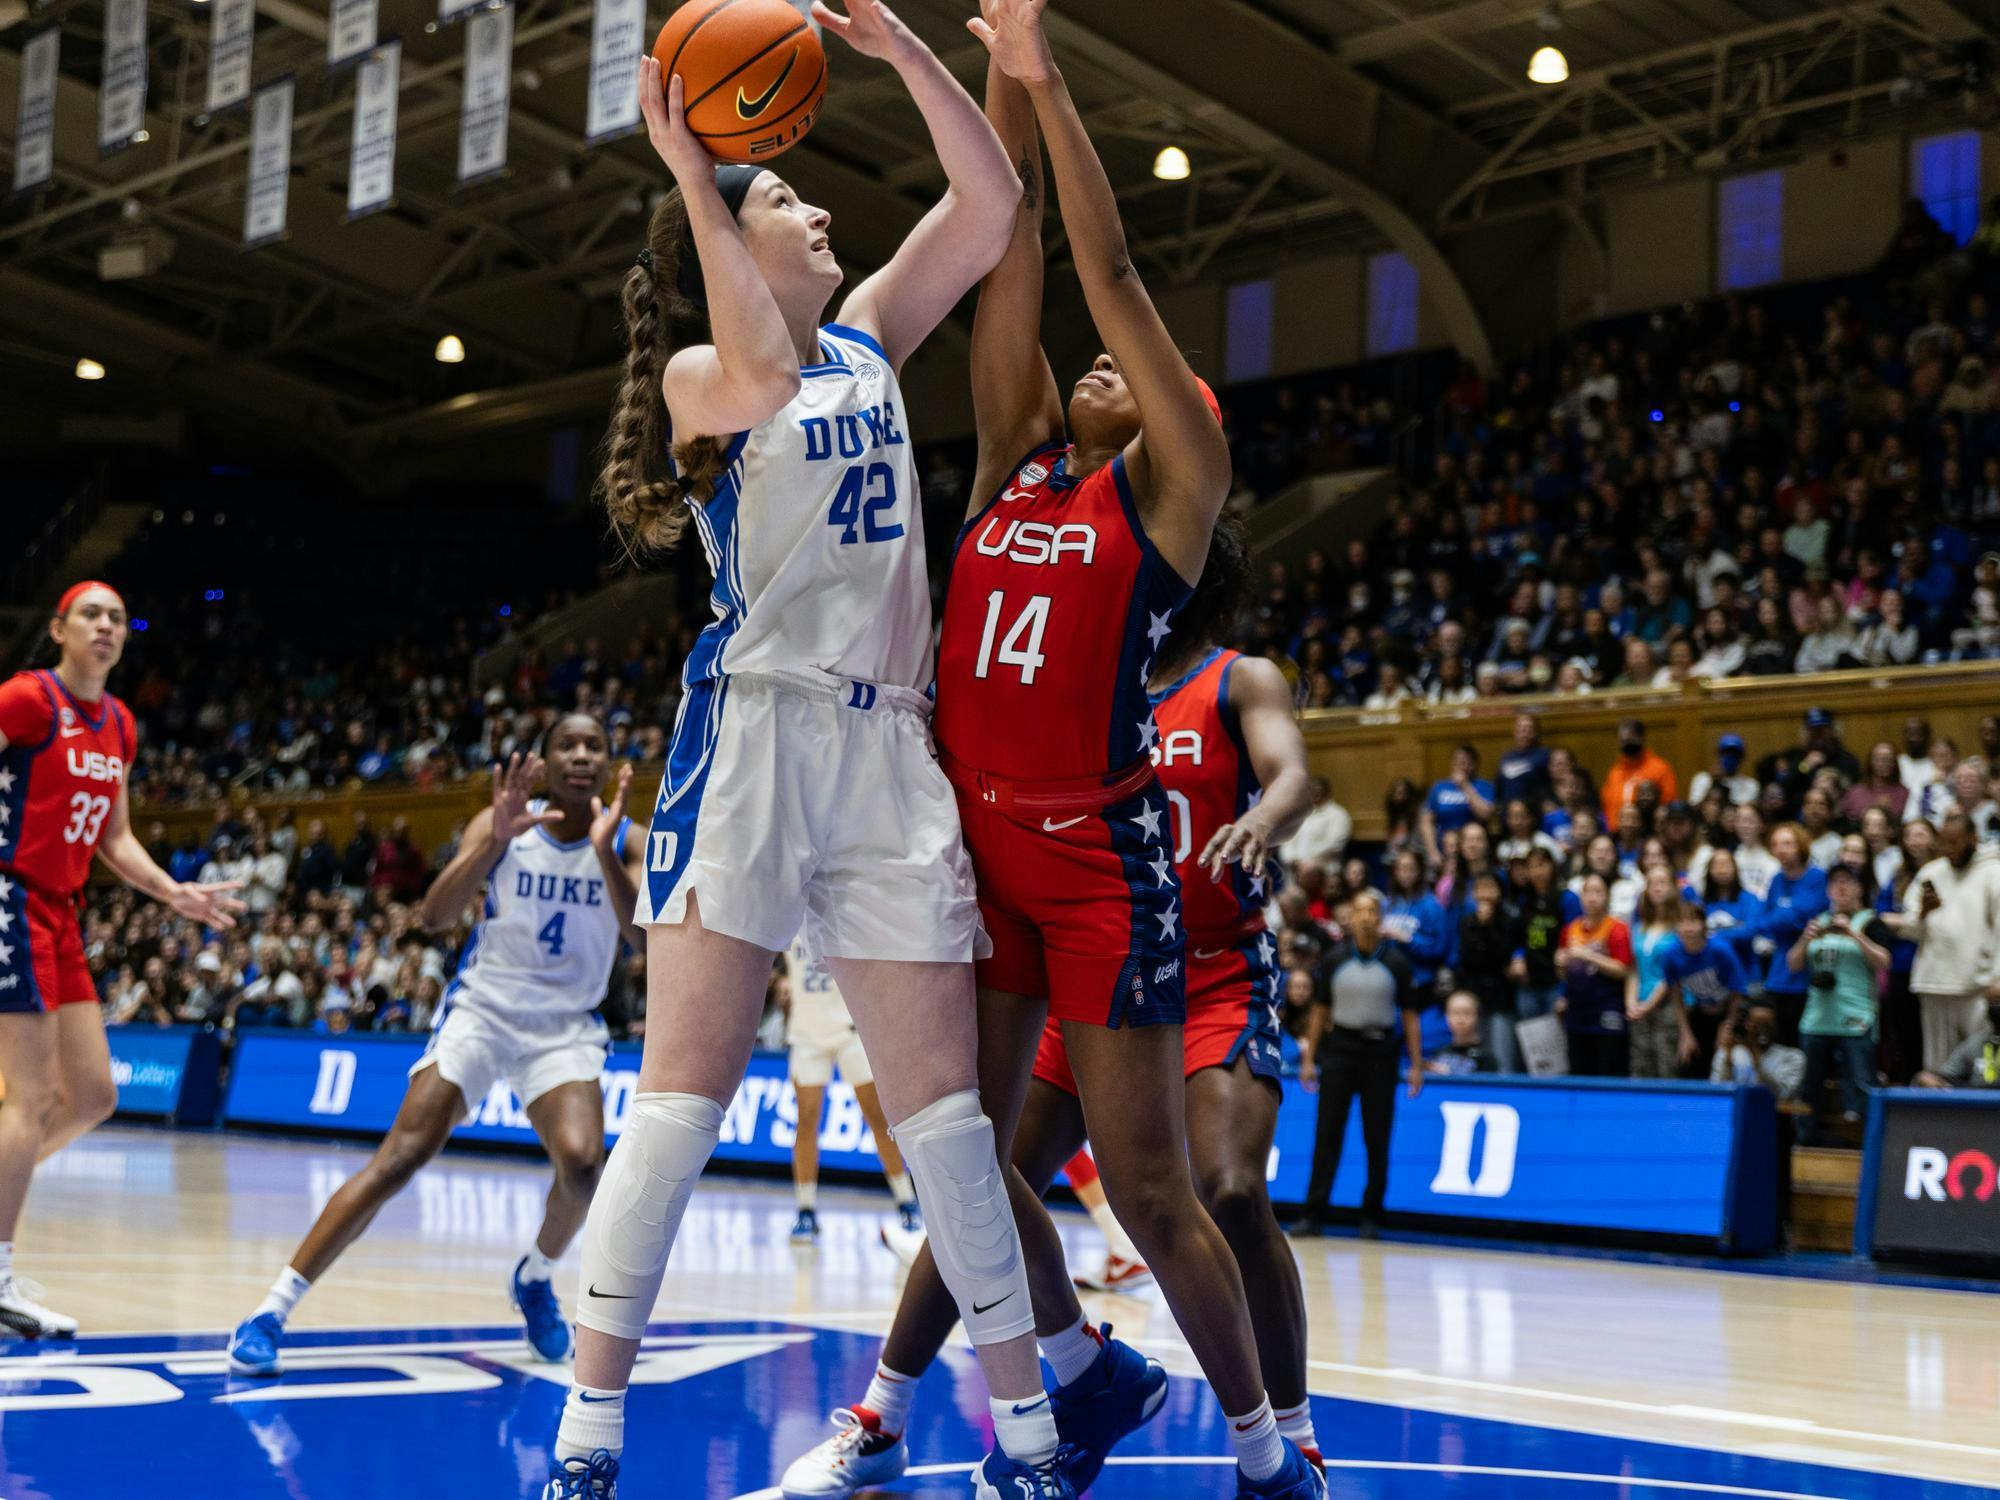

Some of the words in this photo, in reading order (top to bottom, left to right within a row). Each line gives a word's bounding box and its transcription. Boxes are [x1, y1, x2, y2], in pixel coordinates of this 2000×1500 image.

[800, 402, 904, 461] DUKE
[828, 462, 904, 545] 42
[976, 516, 1097, 565] USA
[975, 590, 1051, 685] 14
[848, 681, 877, 710] D
[67, 748, 123, 785] USA
[63, 791, 111, 848] 33
[651, 831, 678, 872] D
[517, 870, 604, 907] DUKE
[538, 911, 567, 956] 4
[1155, 958, 1180, 984] USA
[308, 1049, 357, 1115] D
[1429, 1101, 1520, 1198] D
[1904, 1146, 2000, 1204] RO
